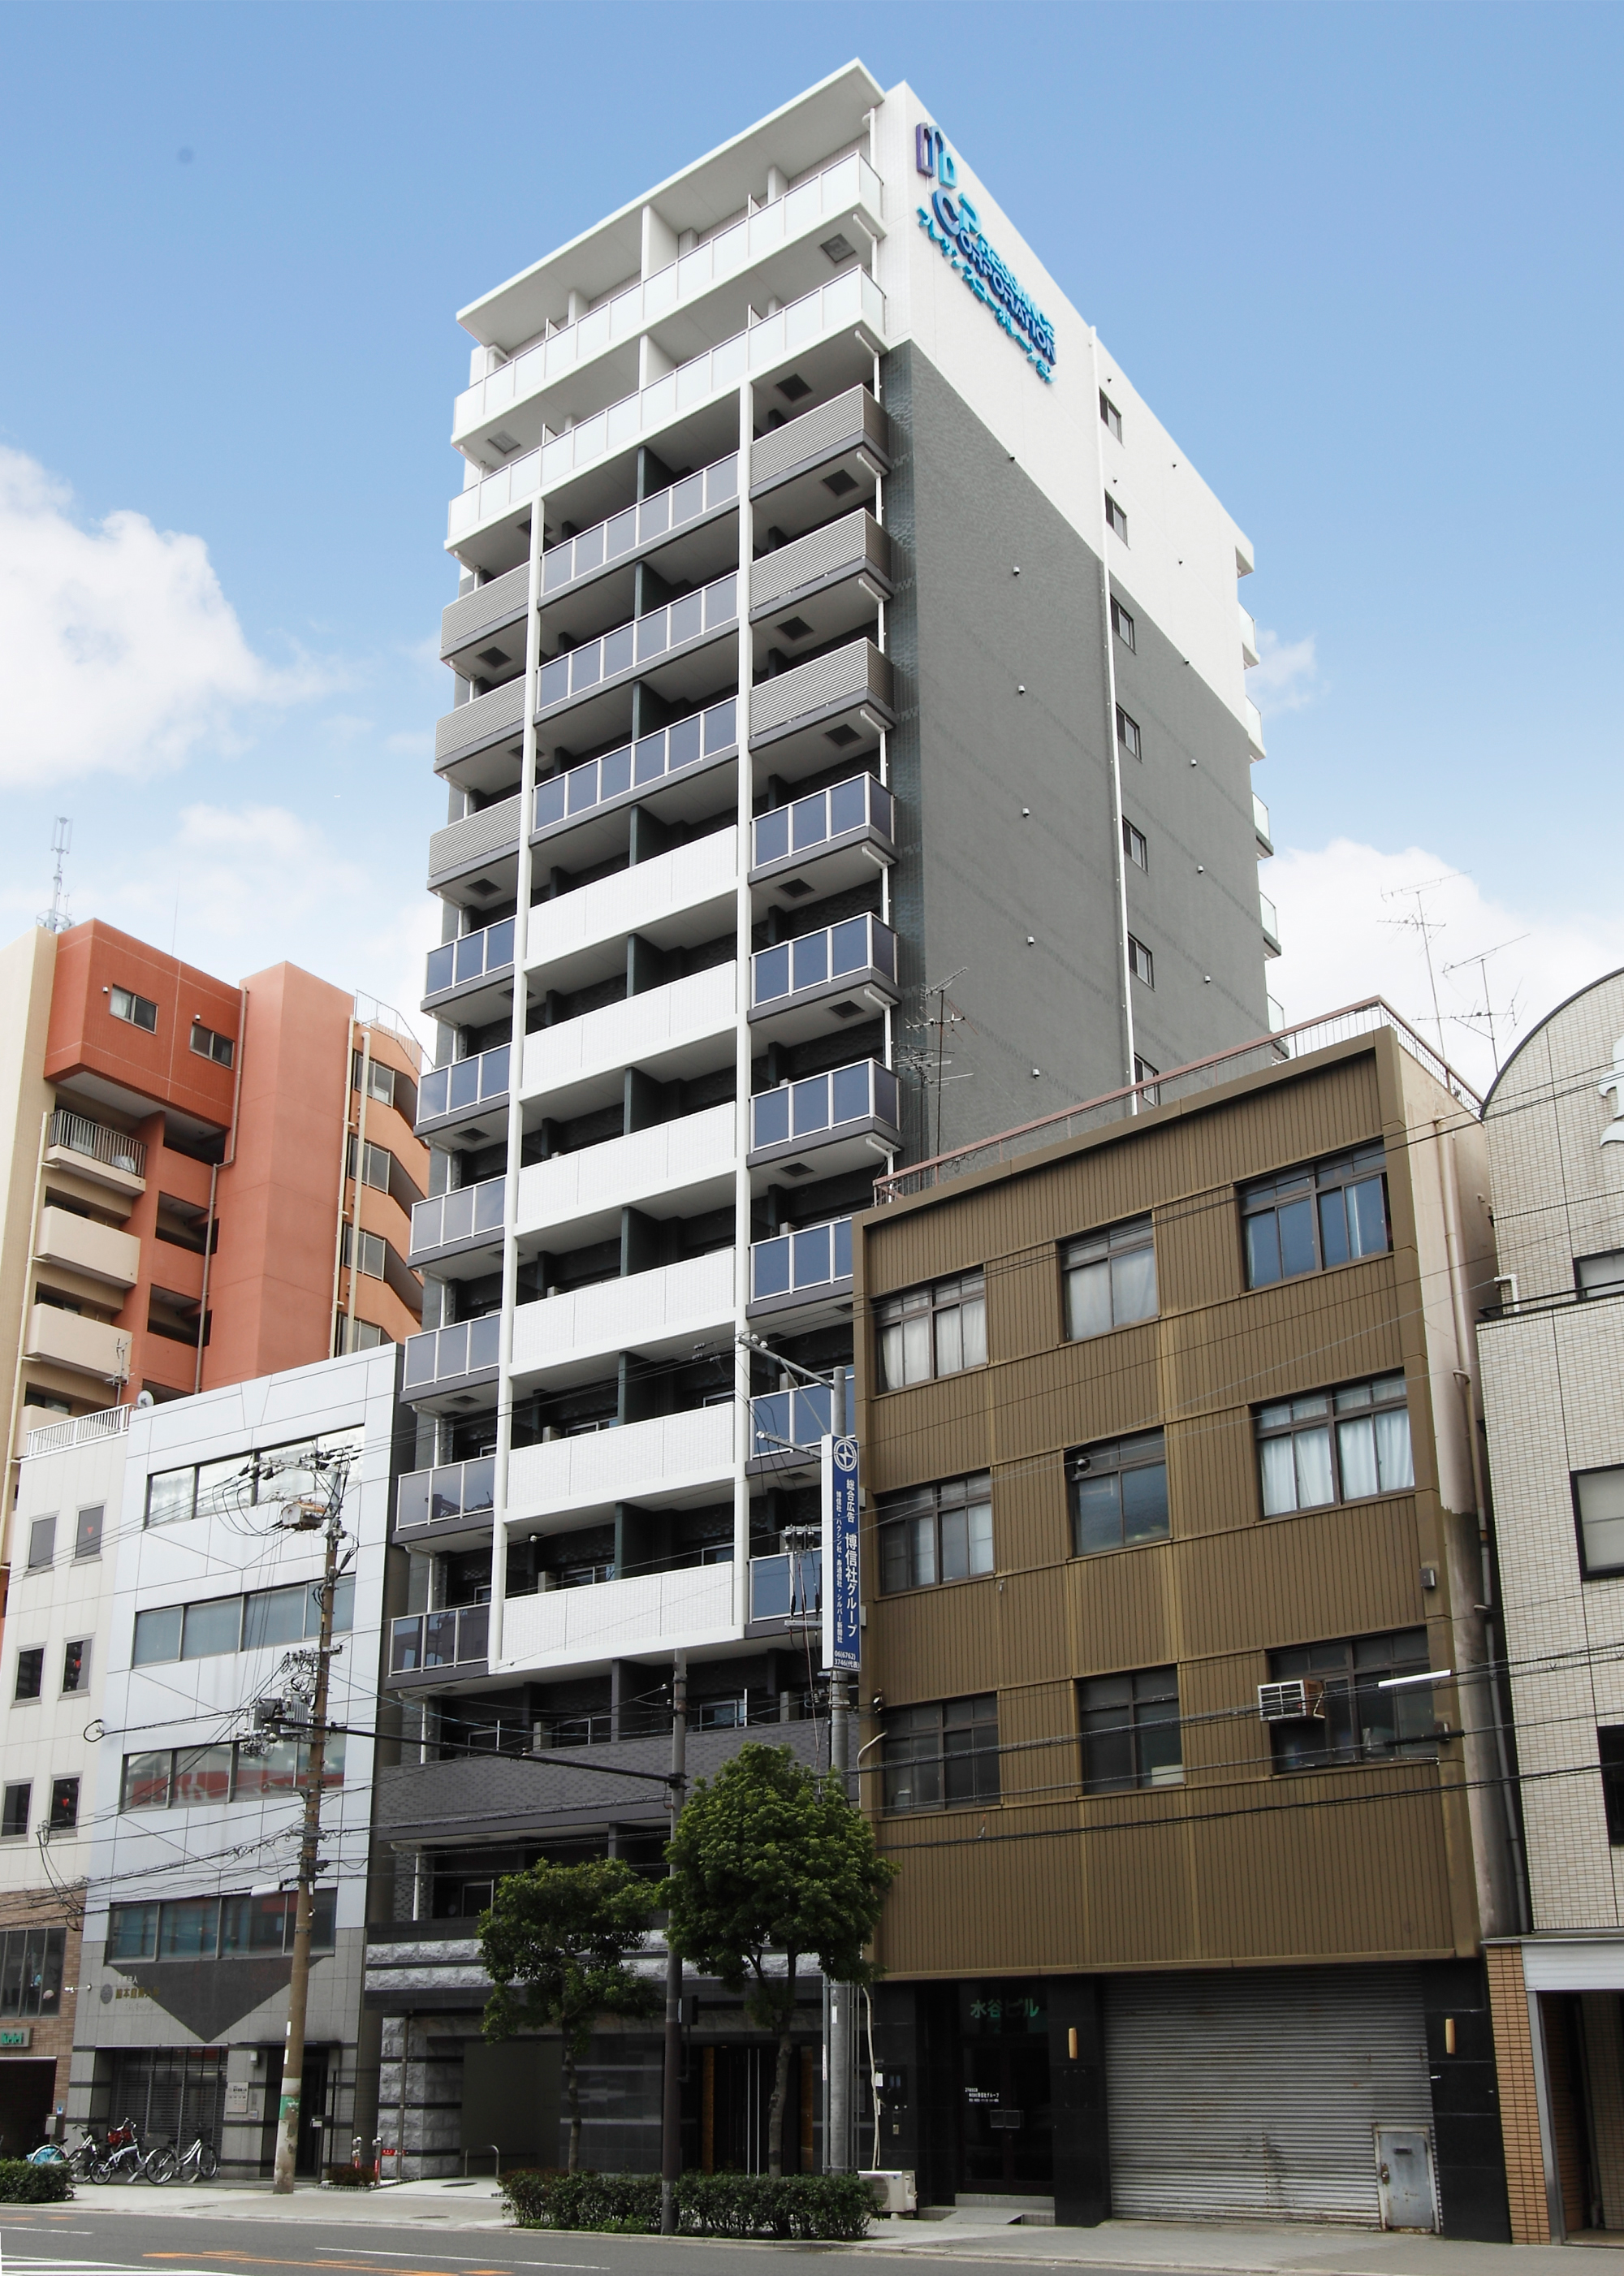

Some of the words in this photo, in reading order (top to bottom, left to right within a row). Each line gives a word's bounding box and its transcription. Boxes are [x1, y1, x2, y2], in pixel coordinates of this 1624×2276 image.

[932, 187, 1056, 365] CORPORATION
[958, 192, 1055, 344] PRESSANCE
[846, 1479, 855, 1523] 総合広告
[845, 1532, 857, 1637] 博信社グループ
[970, 1997, 1039, 2018] 水谷ビル
